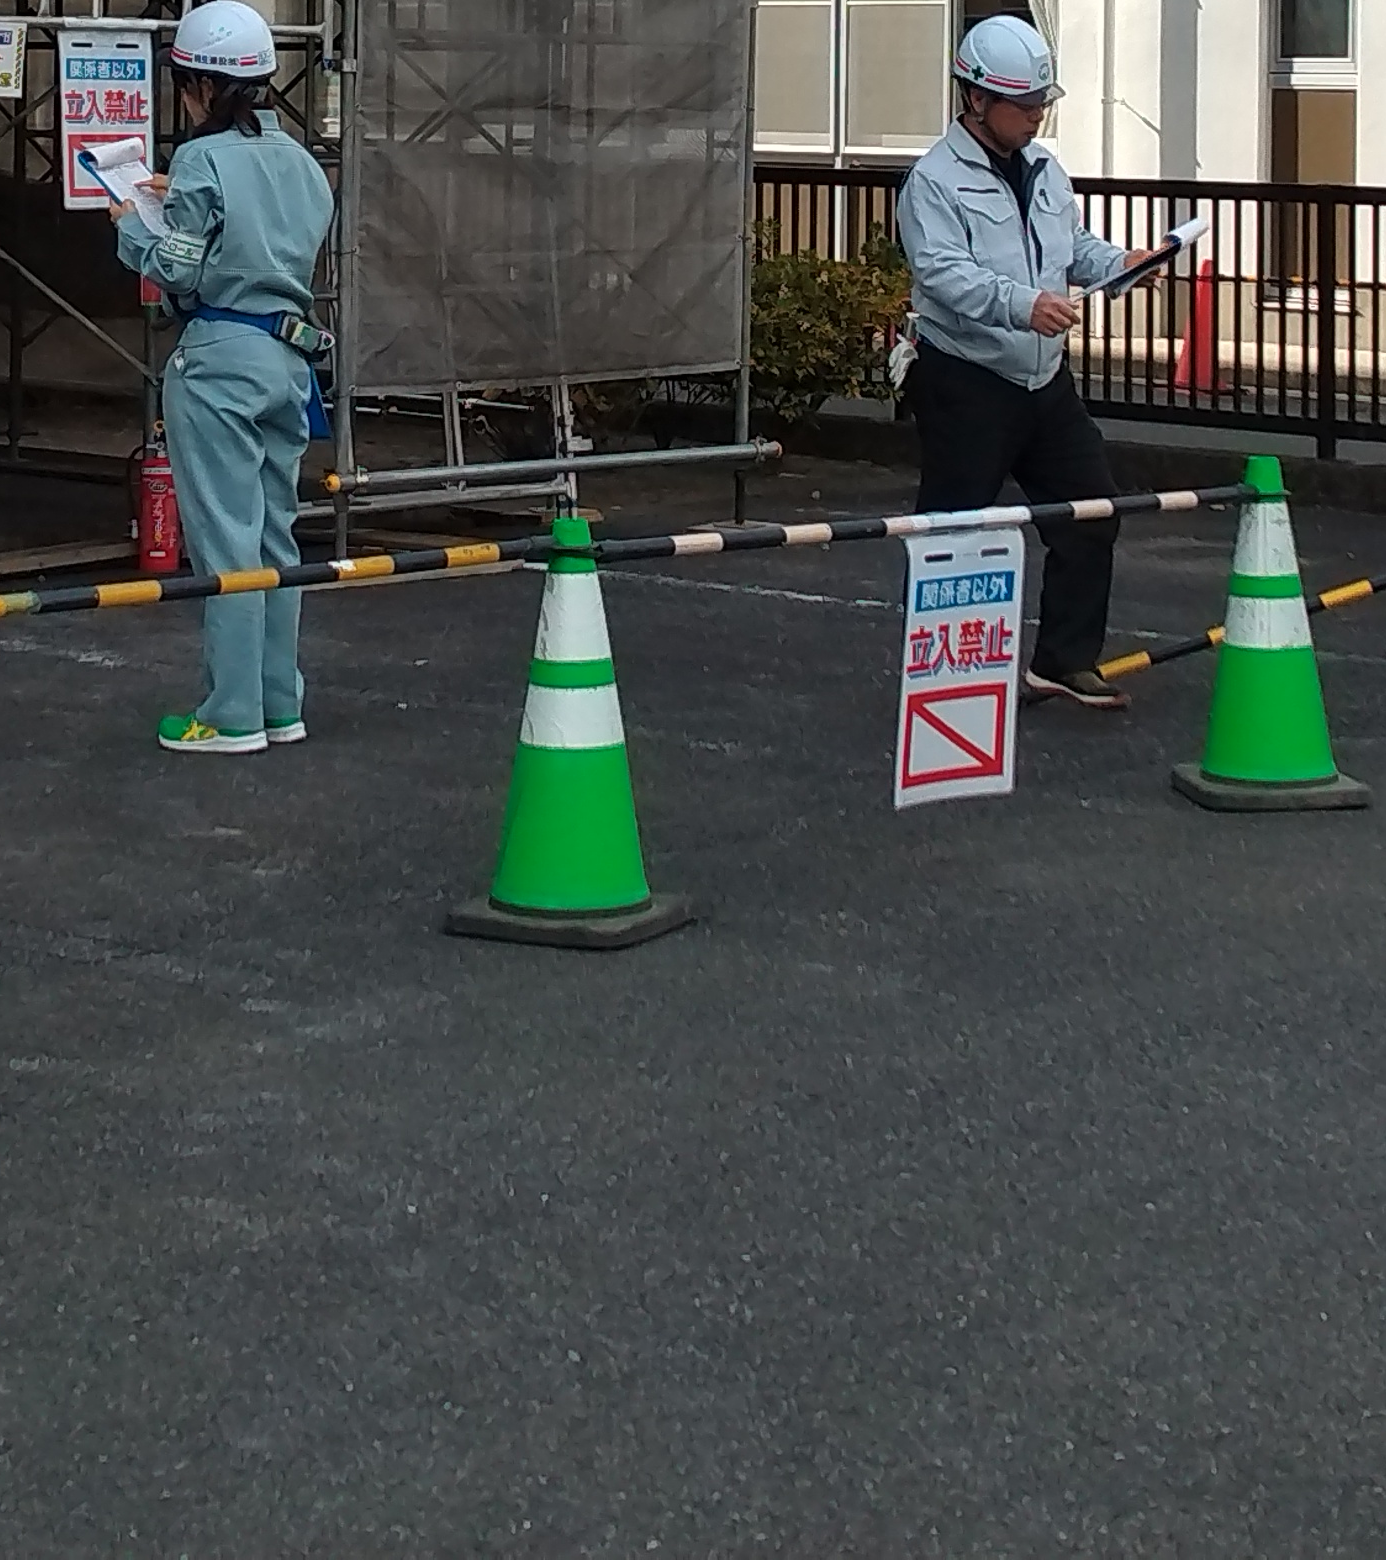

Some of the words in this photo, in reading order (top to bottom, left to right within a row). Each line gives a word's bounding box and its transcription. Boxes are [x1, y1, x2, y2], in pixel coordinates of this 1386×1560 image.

[69, 60, 141, 78] 関係者以外
[64, 90, 149, 124] 立入禁止
[920, 573, 1009, 610] 関係者以外
[906, 615, 1013, 679] 立入禁止
